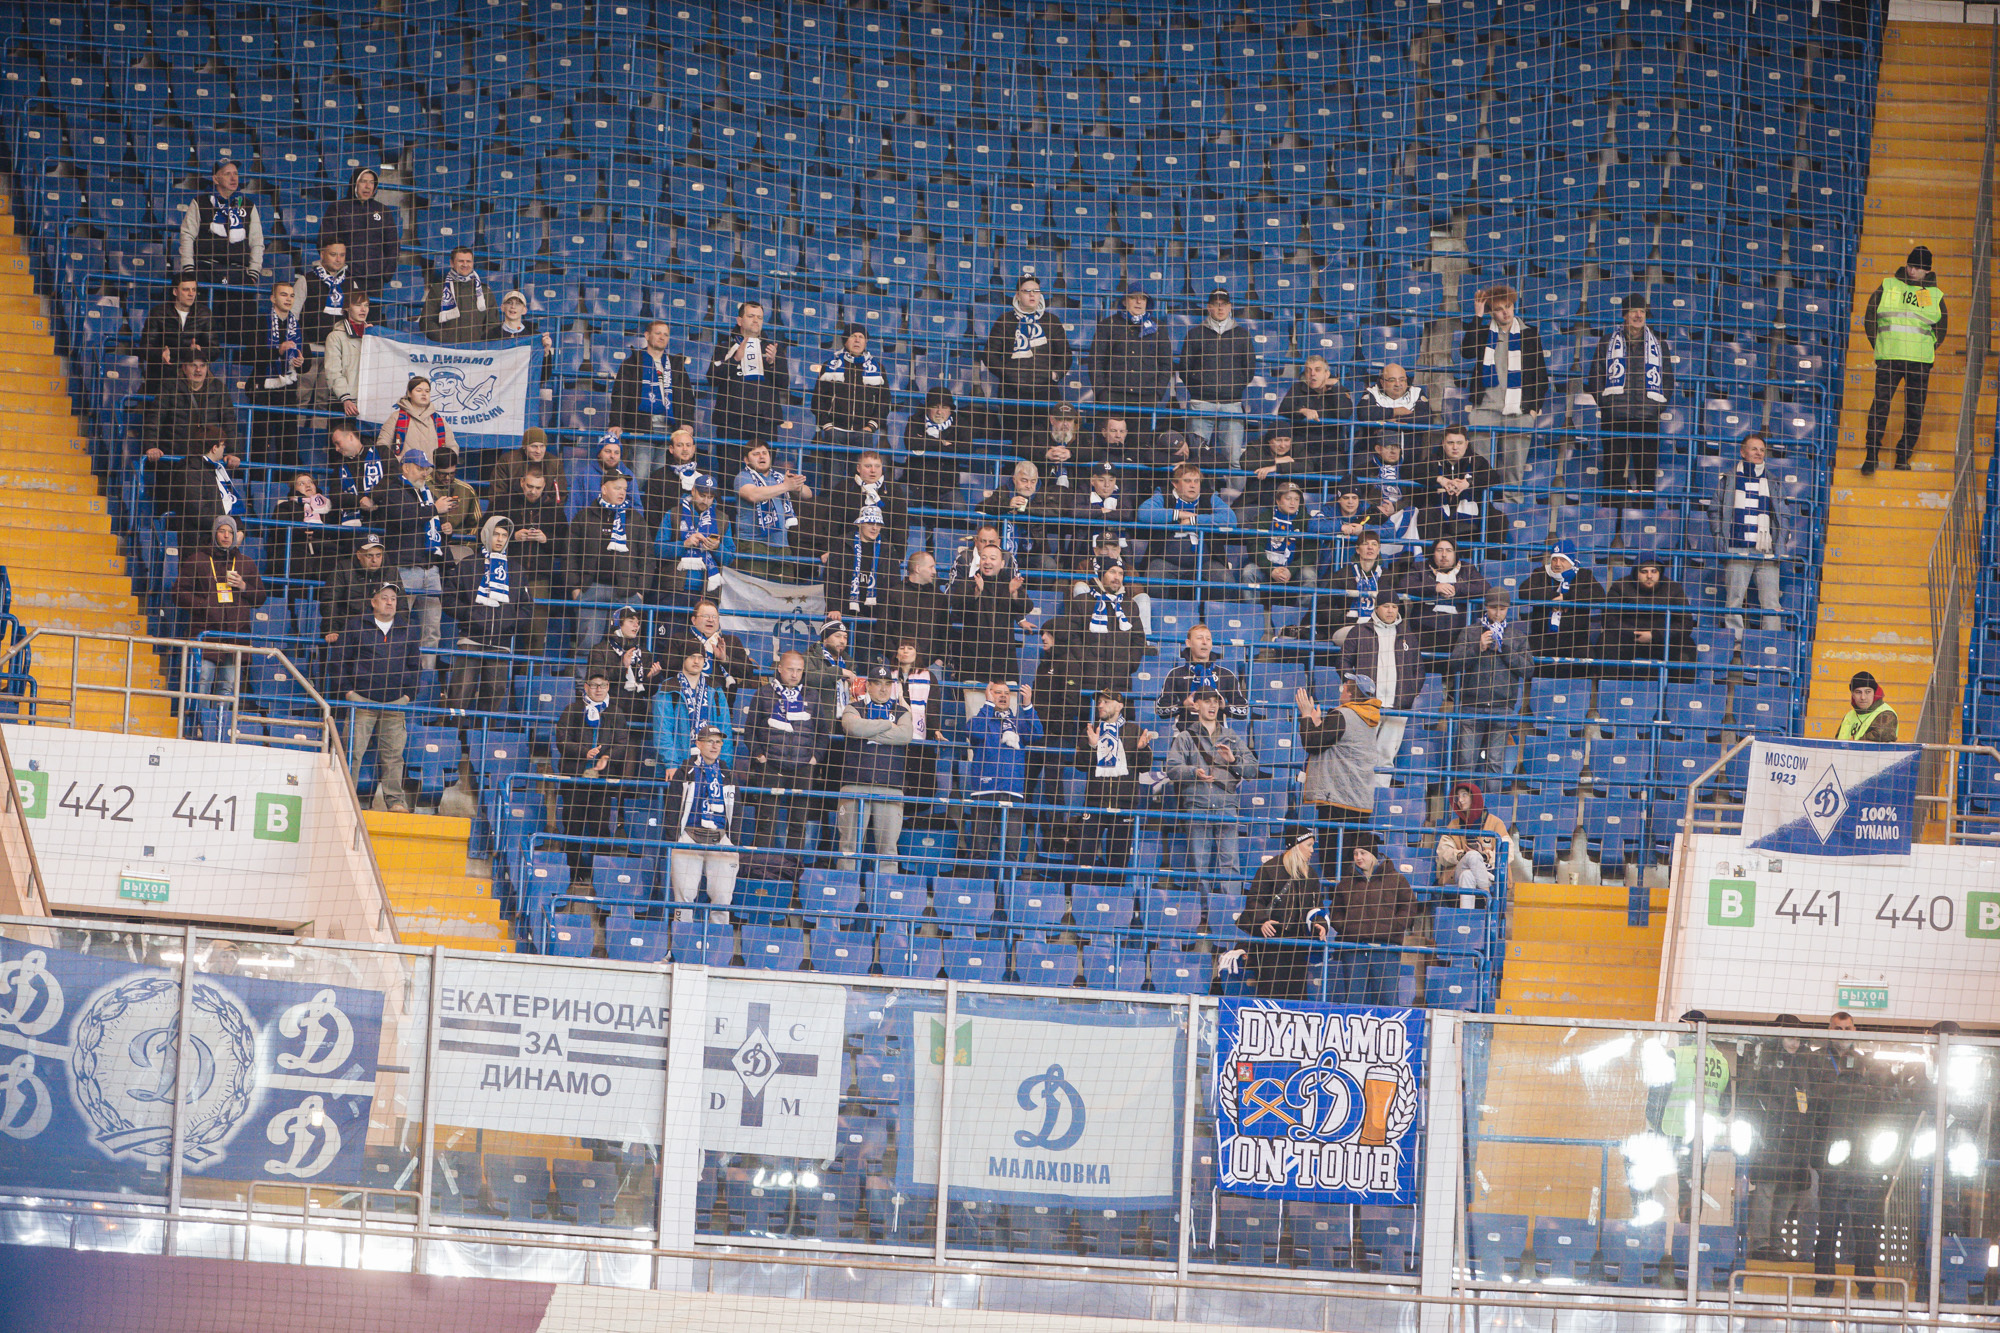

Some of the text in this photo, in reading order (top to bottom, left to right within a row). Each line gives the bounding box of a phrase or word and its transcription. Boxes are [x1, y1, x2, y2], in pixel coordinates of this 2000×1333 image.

[1868, 199, 1882, 209] 22
[12, 259, 24, 270] 19
[1861, 257, 1873, 267] 21
[1903, 291, 1924, 308] 182
[31, 320, 43, 330] 18
[409, 354, 494, 366] ЗА ДИНАМО
[1850, 374, 1861, 384] 19
[49, 381, 60, 391] 17
[461, 405, 505, 425] СИСЬКИ
[1843, 431, 1855, 441] 18
[68, 439, 80, 450] 16
[1979, 437, 1991, 447] 18
[88, 501, 100, 511] 15
[1830, 547, 1842, 557] 16
[107, 559, 120, 569] 14
[1823, 607, 1835, 617] 15
[1817, 665, 1829, 675] 14
[149, 678, 161, 689] 12
[1810, 722, 1822, 732] 13
[1765, 752, 1808, 771] MOSCOW
[1770, 771, 1796, 786] 1923
[59, 781, 135, 822] 442
[172, 791, 237, 832] 441
[1860, 806, 1898, 822] 100%
[1855, 824, 1900, 840] DYNAMO
[123, 881, 167, 895] ВЫХОД
[131, 891, 158, 899] EXIT
[1775, 888, 1841, 926] 441
[1875, 893, 1954, 932] 440
[1841, 990, 1886, 1001] ВЫХОД
[441, 988, 669, 1031] ЕКАТЕРИНОДАР
[1239, 1009, 1405, 1064] DYNAMO
[524, 1031, 563, 1057] ЗА
[480, 1063, 612, 1097] ДИНАМО
[1231, 1135, 1398, 1190] ON TOUR
[988, 1156, 1110, 1185] МАЛАХОВКА
